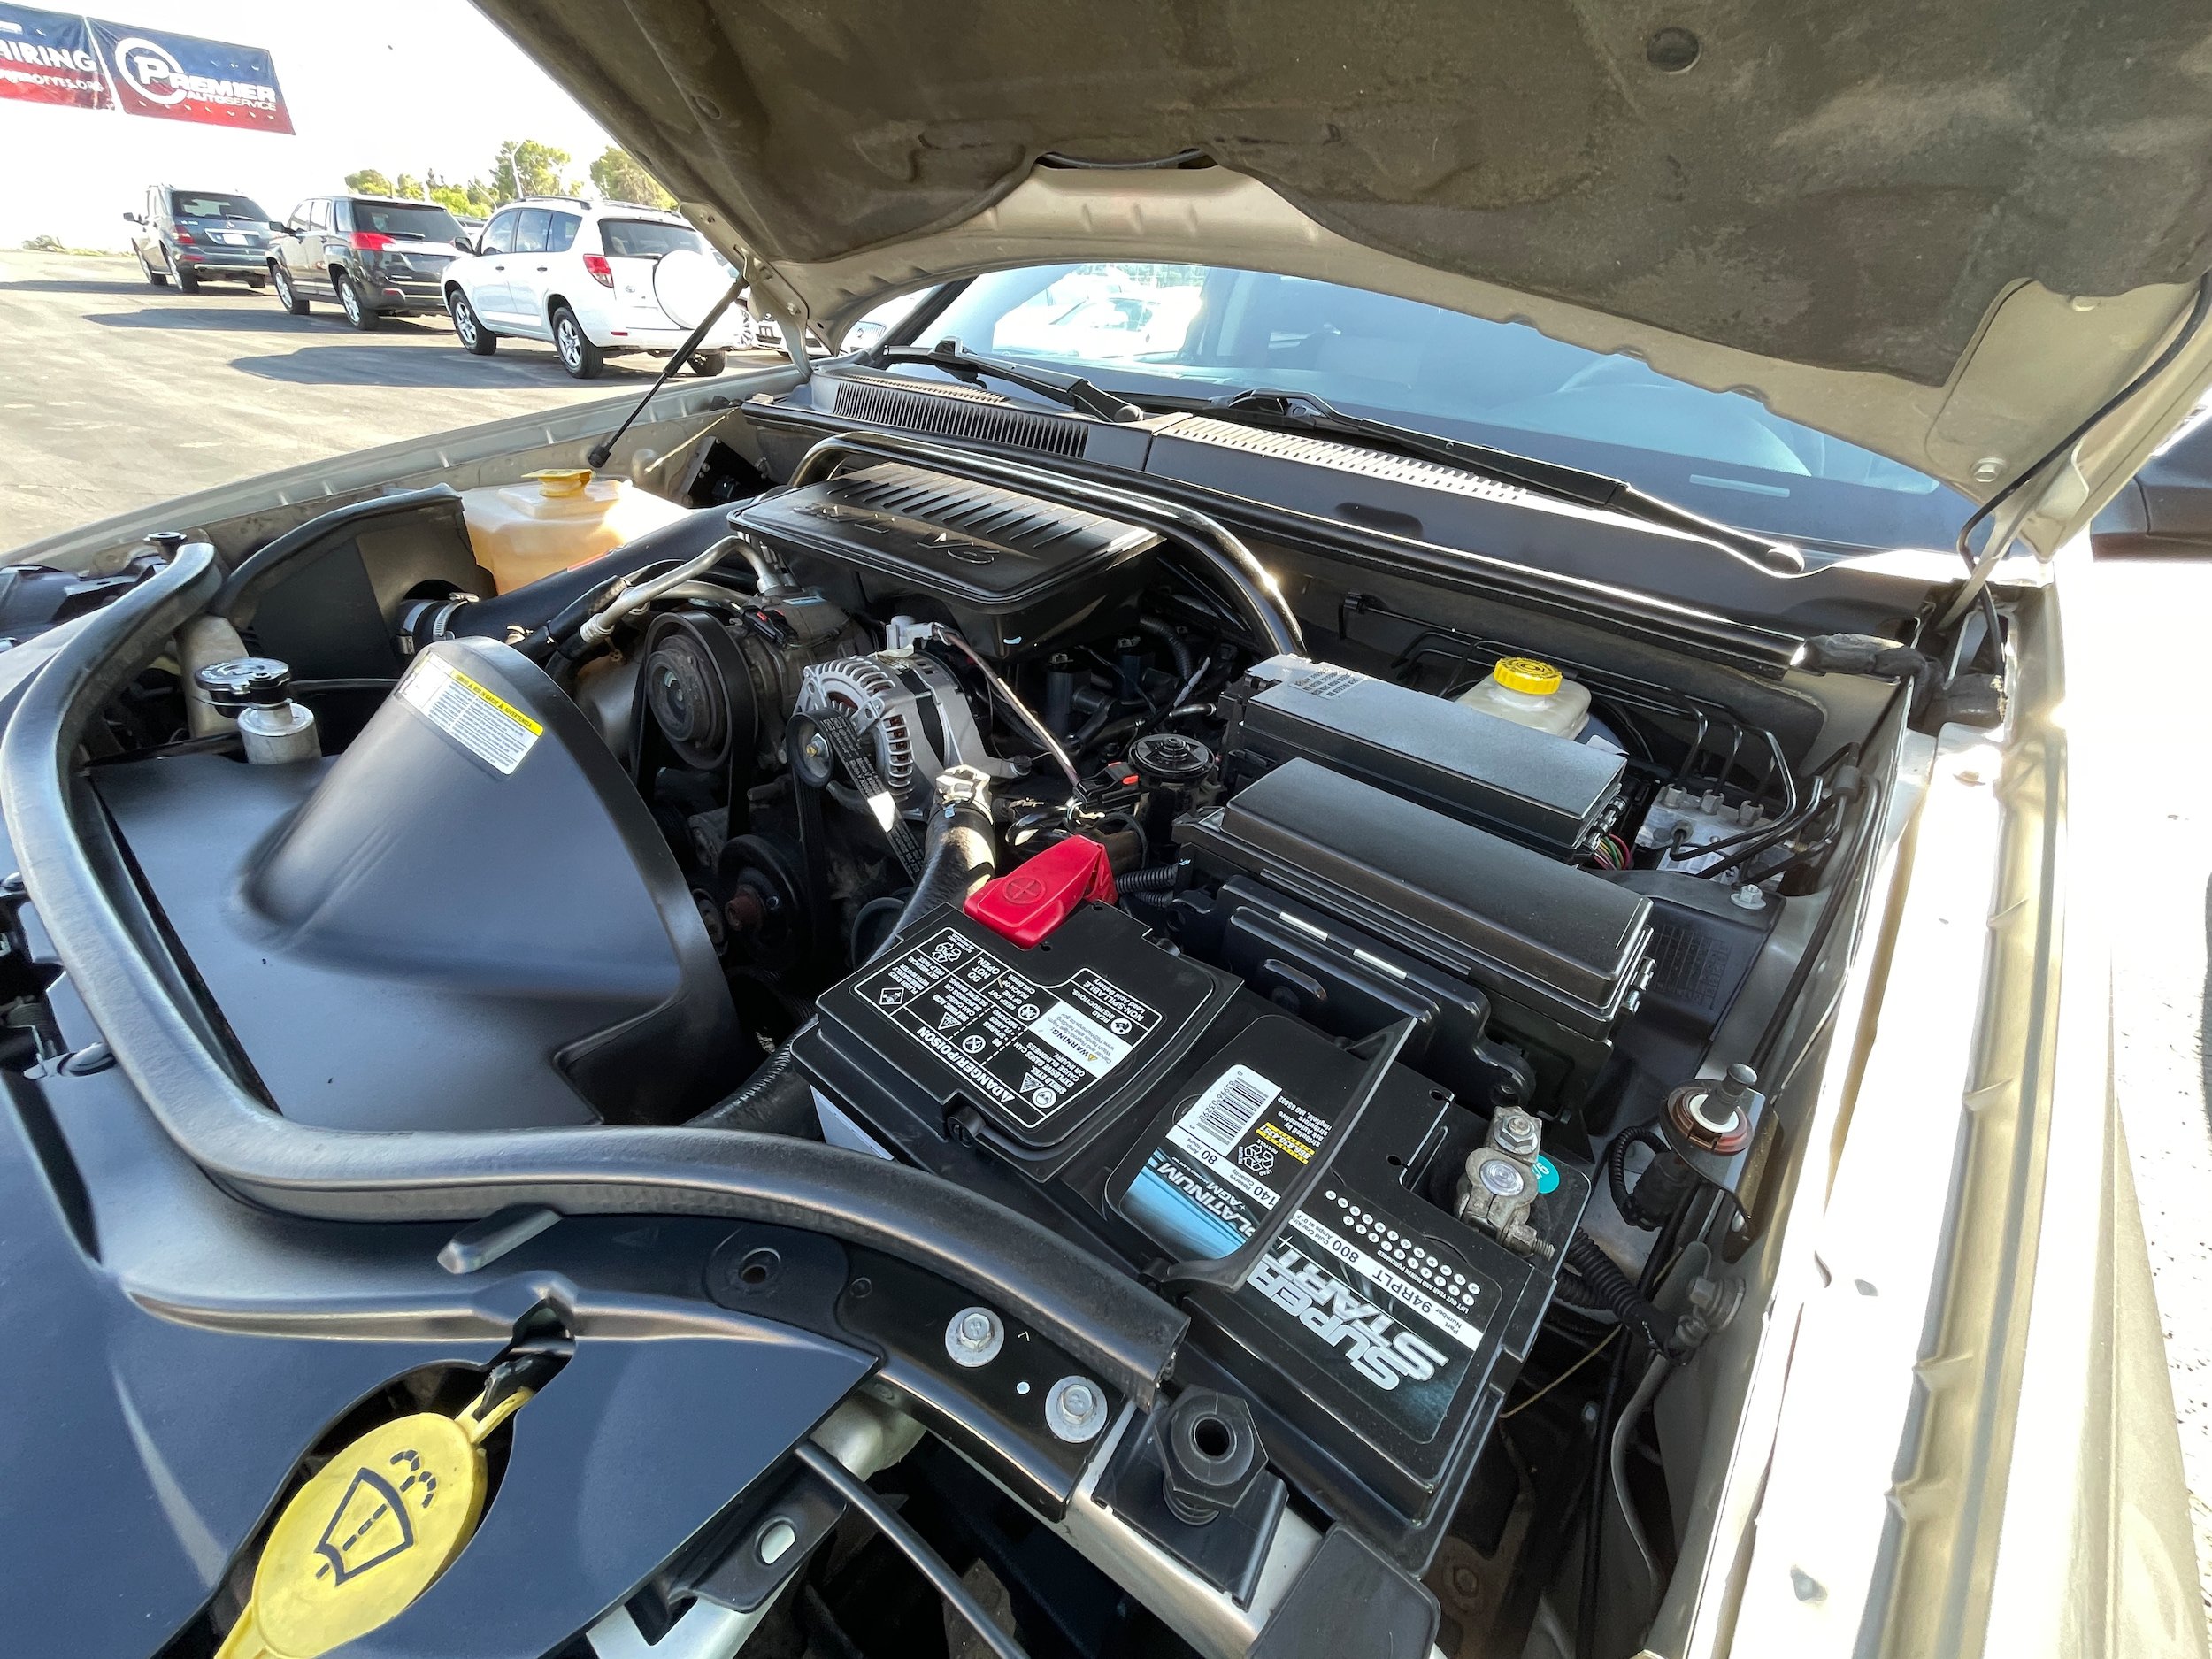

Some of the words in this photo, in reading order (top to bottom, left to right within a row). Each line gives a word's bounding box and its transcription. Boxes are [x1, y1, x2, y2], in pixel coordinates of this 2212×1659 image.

[134, 56, 276, 103] PREMIER
[503, 706, 532, 727] ADVERTENCIA
[906, 956, 930, 972] MEDICAL
[929, 964, 946, 976] HELP
[972, 964, 992, 979] NOT
[975, 956, 1002, 975] OPEN.
[887, 971, 903, 982] EYES
[891, 965, 925, 990] IMMEDIATELY
[915, 975, 930, 986] WITH
[926, 970, 940, 979] GET
[965, 971, 982, 982] DO
[900, 979, 919, 994] FLUSH
[947, 977, 969, 993] BURNS.
[1005, 973, 1036, 995] CHILDREN.
[1008, 984, 1030, 1000] REACH
[1091, 978, 1117, 995] Battery
[931, 993, 948, 1004] ACID
[944, 993, 964, 1008] CAUSE
[951, 988, 983, 1011] BLINDNESS
[965, 990, 989, 1007] SEVERE
[987, 988, 1002, 1000] OUT
[1082, 979, 1144, 1022] NON-SPILLABLE
[1113, 992, 1130, 1003] Acid
[961, 1005, 976, 1016] CAN
[998, 997, 1017, 1010] KEEP
[1070, 988, 1115, 1019] INSTRUCTIONS.
[1127, 1001, 1146, 1013] Lead
[942, 1002, 970, 1022] SULFURIC
[991, 1009, 1018, 1028] SMOKING
[1091, 1010, 1110, 1023] READ
[982, 1020, 1007, 1038] SPARKS
[988, 1016, 1012, 1033] FLAMES
[1072, 1028, 1085, 1037] after
[991, 1037, 1003, 1047] NO
[1048, 1026, 1090, 1056] WARNING:
[1058, 1025, 1087, 1046] Reproductive
[1082, 1035, 1099, 1047] hands
[1012, 1041, 1029, 1054] CAN
[1025, 1041, 1061, 1067] BLINDNESS
[1085, 1043, 1096, 1052] and
[1096, 1044, 1111, 1056] Wash
[913, 1025, 1007, 1097] DANGER/POISON
[1024, 1049, 1046, 1066] GASES
[1051, 1051, 1076, 1070] INJURY.
[1094, 1050, 1112, 1064] Cancer
[1028, 1064, 1048, 1079] EYES.
[1041, 1063, 1075, 1087] EXPLOSIVE
[1056, 1064, 1080, 1082] CAUSE
[1073, 1067, 1086, 1077] OR
[1043, 1077, 1067, 1094] SHIELD
[1277, 1095, 1296, 1110] 65802
[1294, 1106, 1307, 1116] MO
[1277, 1110, 1313, 1134] Automotive
[1297, 1116, 1328, 1136] stributors
[1305, 1111, 1332, 1131] ringfield,
[1186, 1137, 1202, 1149] Hours
[1290, 1127, 1321, 1148] stributed
[1185, 1143, 1199, 1154] Amp
[1256, 1138, 1278, 1154] RECYCLE
[1200, 1149, 1218, 1164] 80
[1228, 1173, 1251, 1190] Reserve
[1230, 1168, 1256, 1187] Capacity
[1252, 1185, 1278, 1207] 140
[1313, 1232, 1329, 1245] Cold
[1315, 1225, 1333, 1240] Amps
[1330, 1238, 1360, 1263] 800
[1376, 1248, 1406, 1271] PURCHASED
[1403, 1265, 1423, 1284] MONTH
[1371, 1266, 1433, 1314] 94RPLT
[1421, 1279, 1433, 1290] AND
[1432, 1285, 1447, 1300] YEAR
[1445, 1294, 1457, 1306] OUT
[1455, 1301, 1470, 1315] LIFT
[1261, 1248, 1448, 1382] START
[1434, 1307, 1462, 1329] Number
[1245, 1259, 1400, 1392] SUPER
[1443, 1320, 1459, 1334] Part
